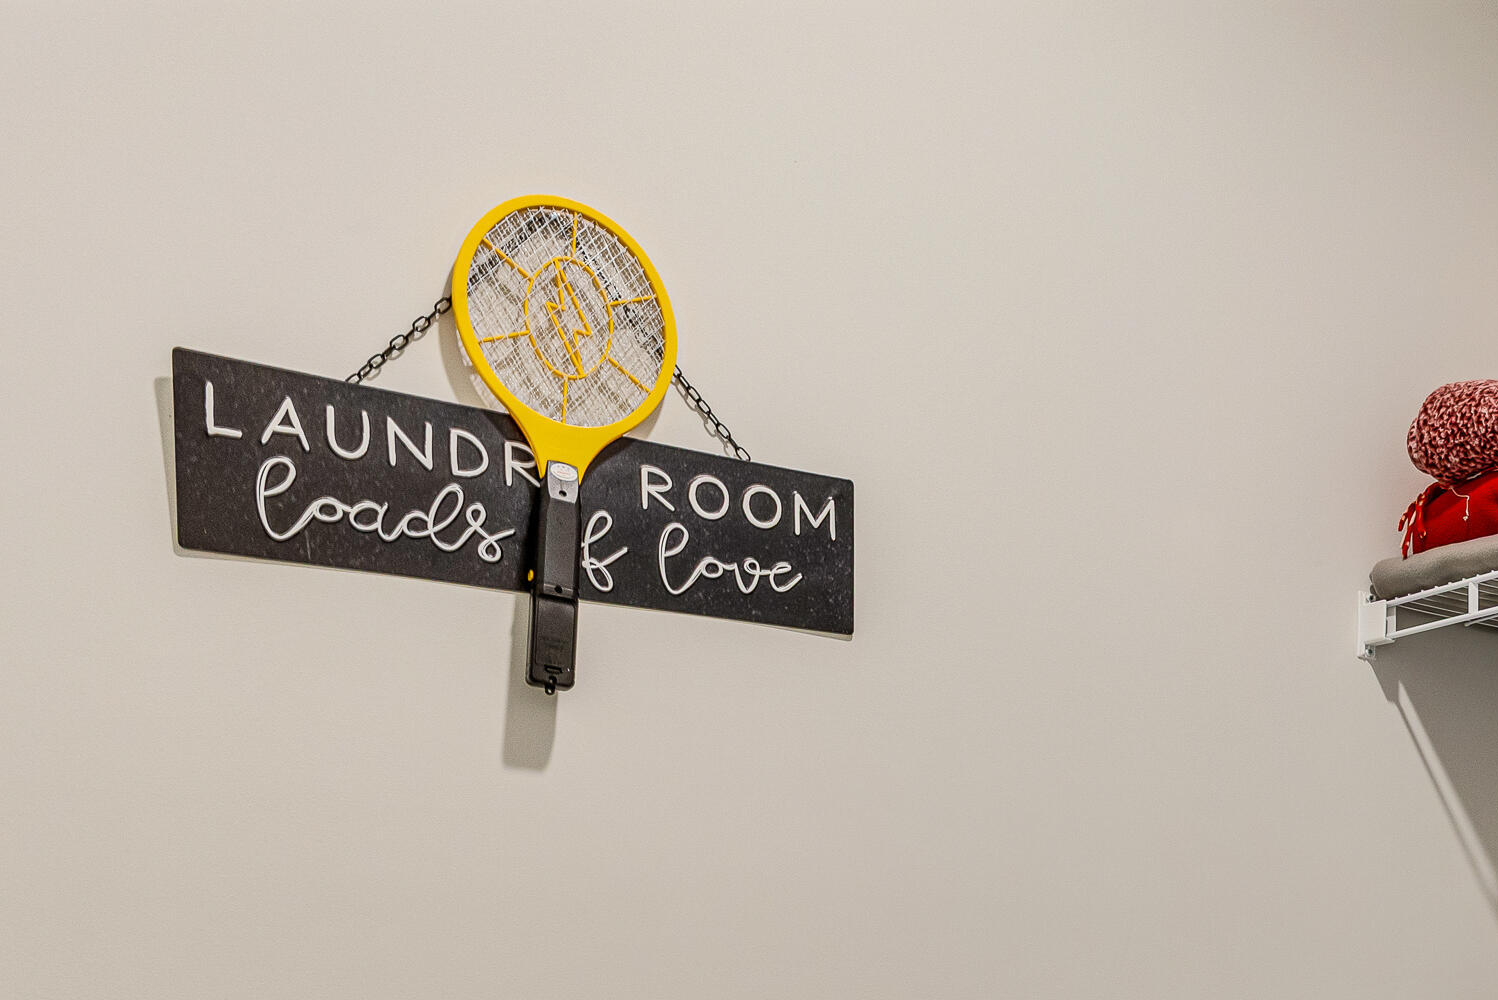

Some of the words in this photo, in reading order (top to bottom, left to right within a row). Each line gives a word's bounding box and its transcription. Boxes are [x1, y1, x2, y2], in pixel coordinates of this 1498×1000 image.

[203, 380, 543, 489] LAUNDR
[641, 464, 837, 542] ROOM
[581, 509, 629, 592] f
[658, 521, 804, 595] love
